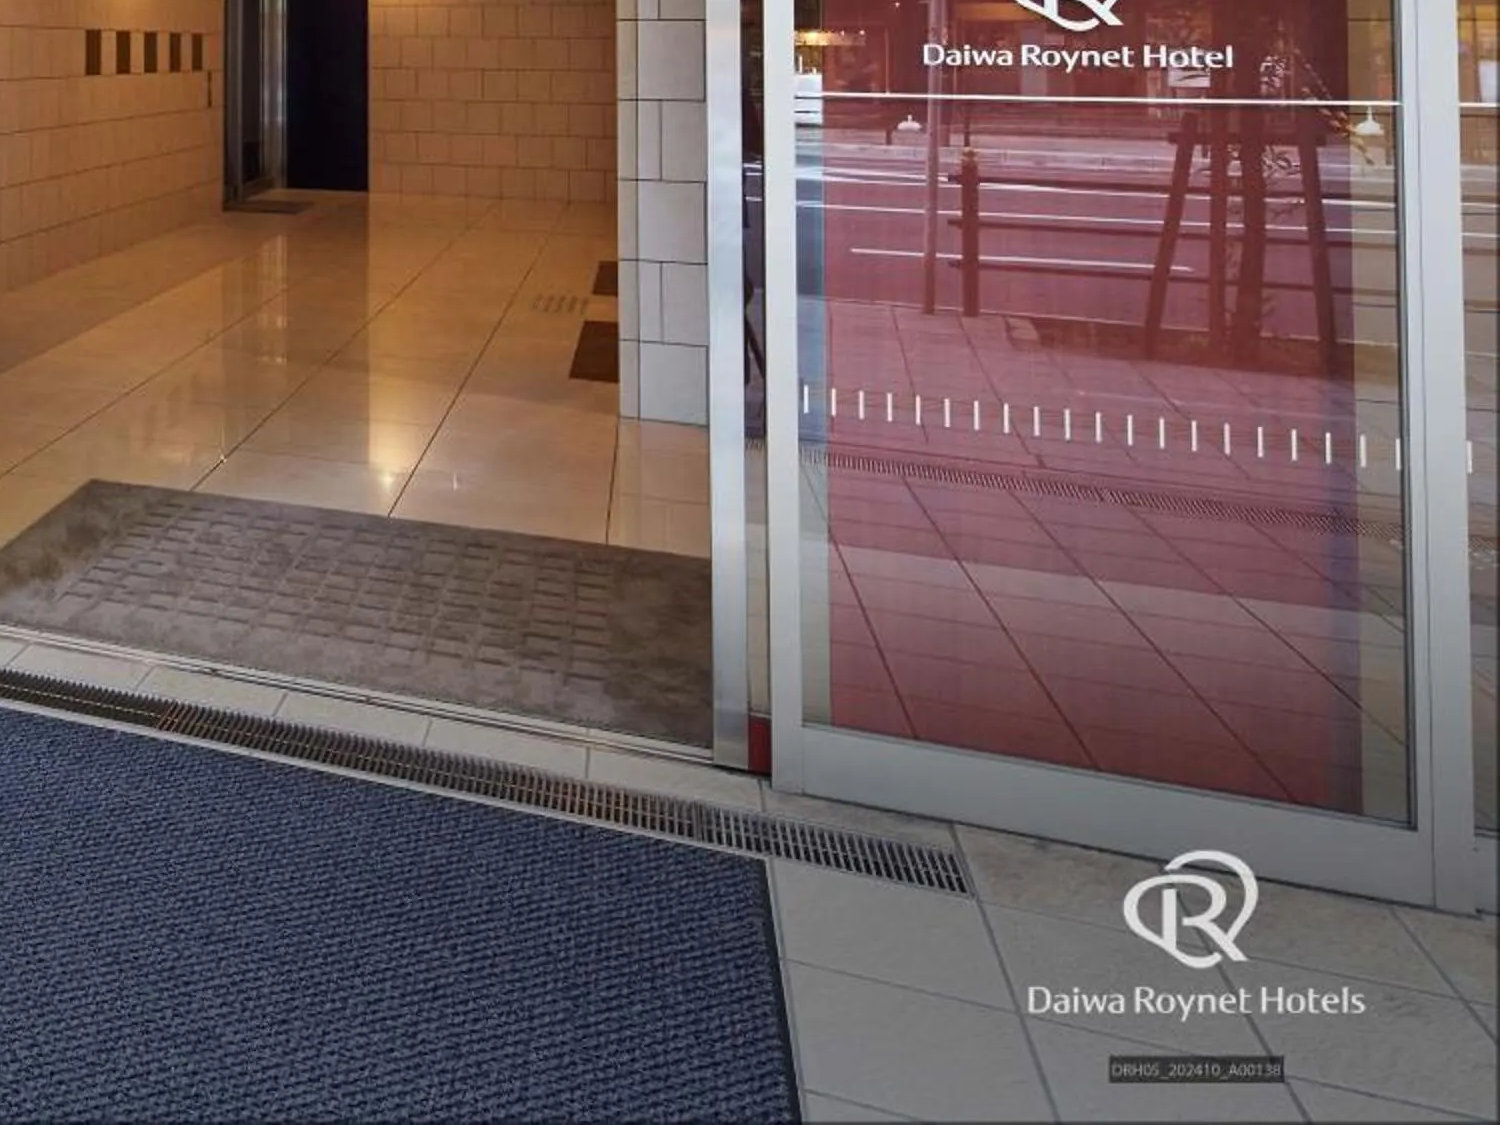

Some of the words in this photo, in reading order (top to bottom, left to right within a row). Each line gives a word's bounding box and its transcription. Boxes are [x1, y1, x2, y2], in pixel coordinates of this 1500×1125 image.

[922, 43, 1013, 68] Daiwa
[1020, 44, 1134, 74] Roynet
[1142, 44, 1234, 69] Hotel
